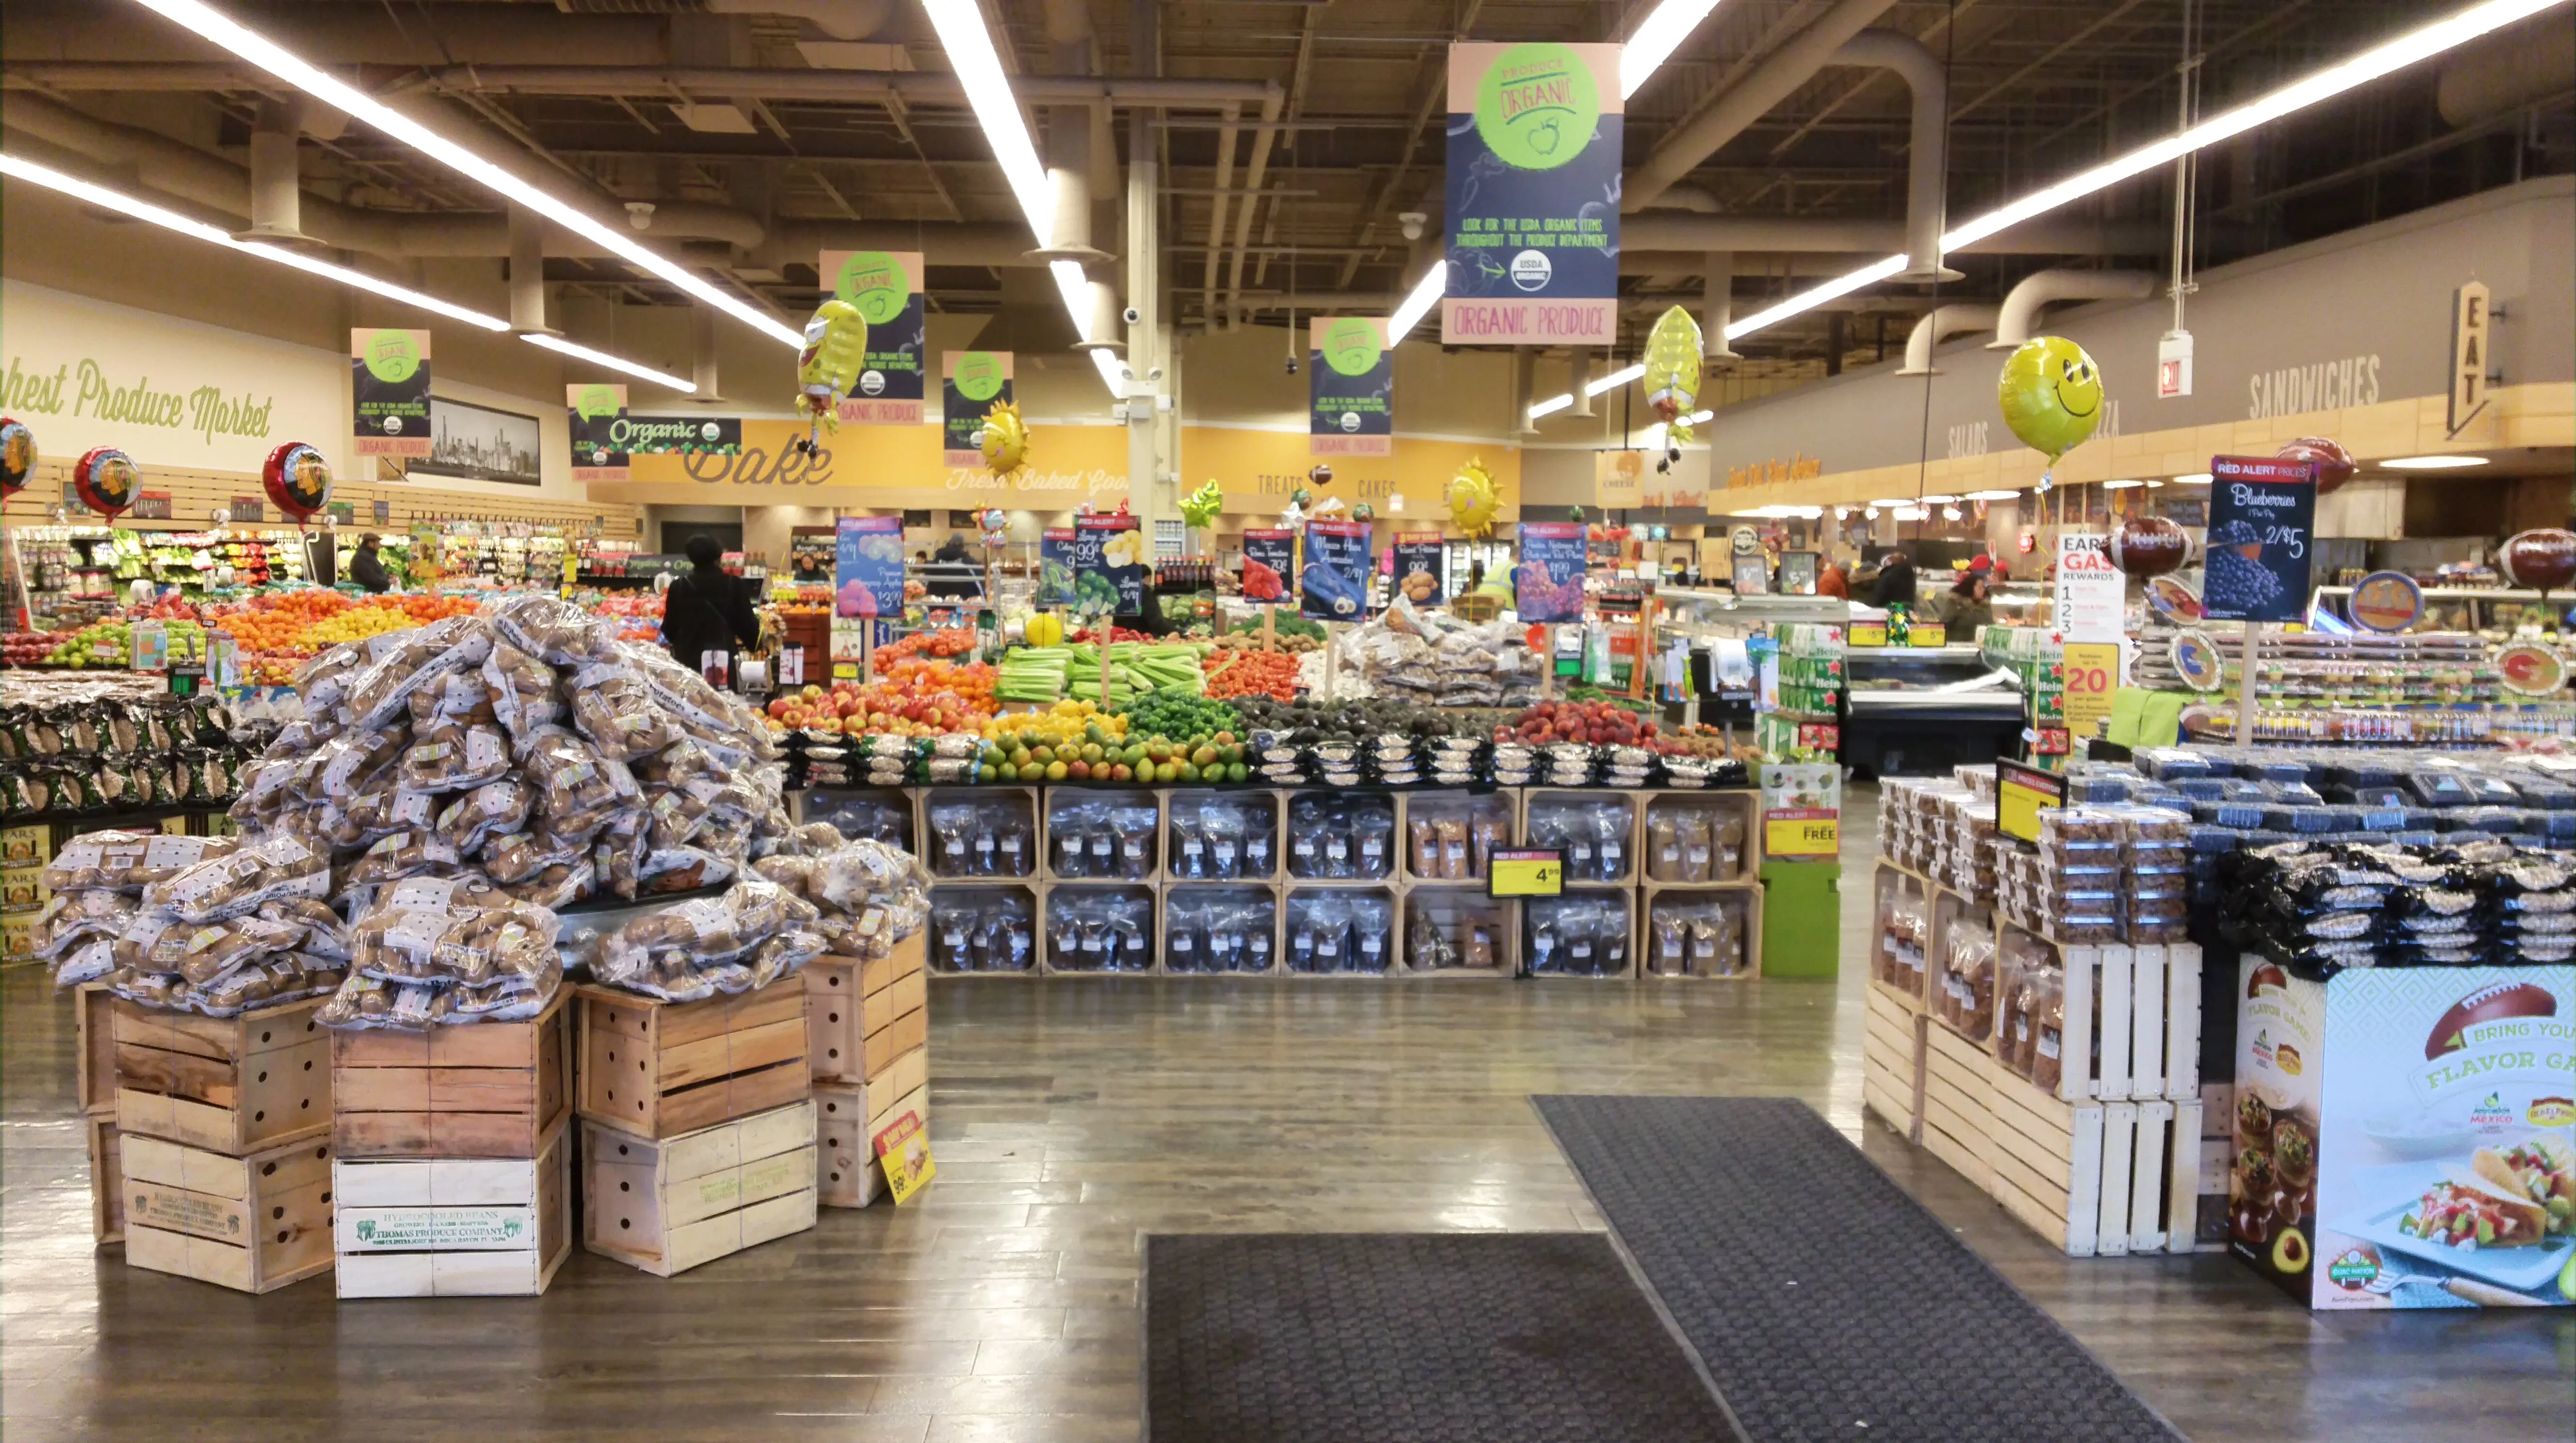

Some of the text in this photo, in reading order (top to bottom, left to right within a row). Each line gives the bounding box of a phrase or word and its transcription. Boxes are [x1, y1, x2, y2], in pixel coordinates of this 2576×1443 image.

[1500, 78, 1576, 120] ORGANIC
[1520, 260, 1543, 269] USDA
[1455, 305, 1605, 335] ORGANIC PRODUCE
[2464, 296, 2482, 405] EAT
[2163, 362, 2180, 394] EXIT
[2249, 353, 2381, 420] SANDWICHES
[74, 358, 183, 428] Produce
[190, 385, 272, 446] Market
[610, 419, 697, 453] Organic
[1948, 421, 1988, 459] SALADS
[2217, 463, 2240, 474] RED
[2242, 465, 2277, 476] ALERT
[1016, 468, 1084, 491] Baked
[1087, 468, 1129, 497] Goo
[1258, 475, 1304, 495] TREATS
[1358, 480, 1396, 498] CAKES
[2231, 483, 2296, 507] Blueberries
[2064, 537, 2101, 552] EAR
[2266, 525, 2304, 559] 2/$5
[2064, 552, 2114, 571] GAS
[2063, 572, 2114, 581] REWARDS
[2062, 585, 2073, 600] 1
[2061, 604, 2072, 617] 2
[2061, 619, 2071, 634] 3
[1803, 829, 1836, 840] FREE
[2474, 1024, 2576, 1042] BRING YOU
[2426, 1052, 2576, 1089] FLAVOR GA
[384, 1212, 464, 1222] HYDROCOOLED
[415, 1229, 457, 1237] PRODUCE
[459, 1227, 504, 1236] COMPANY
